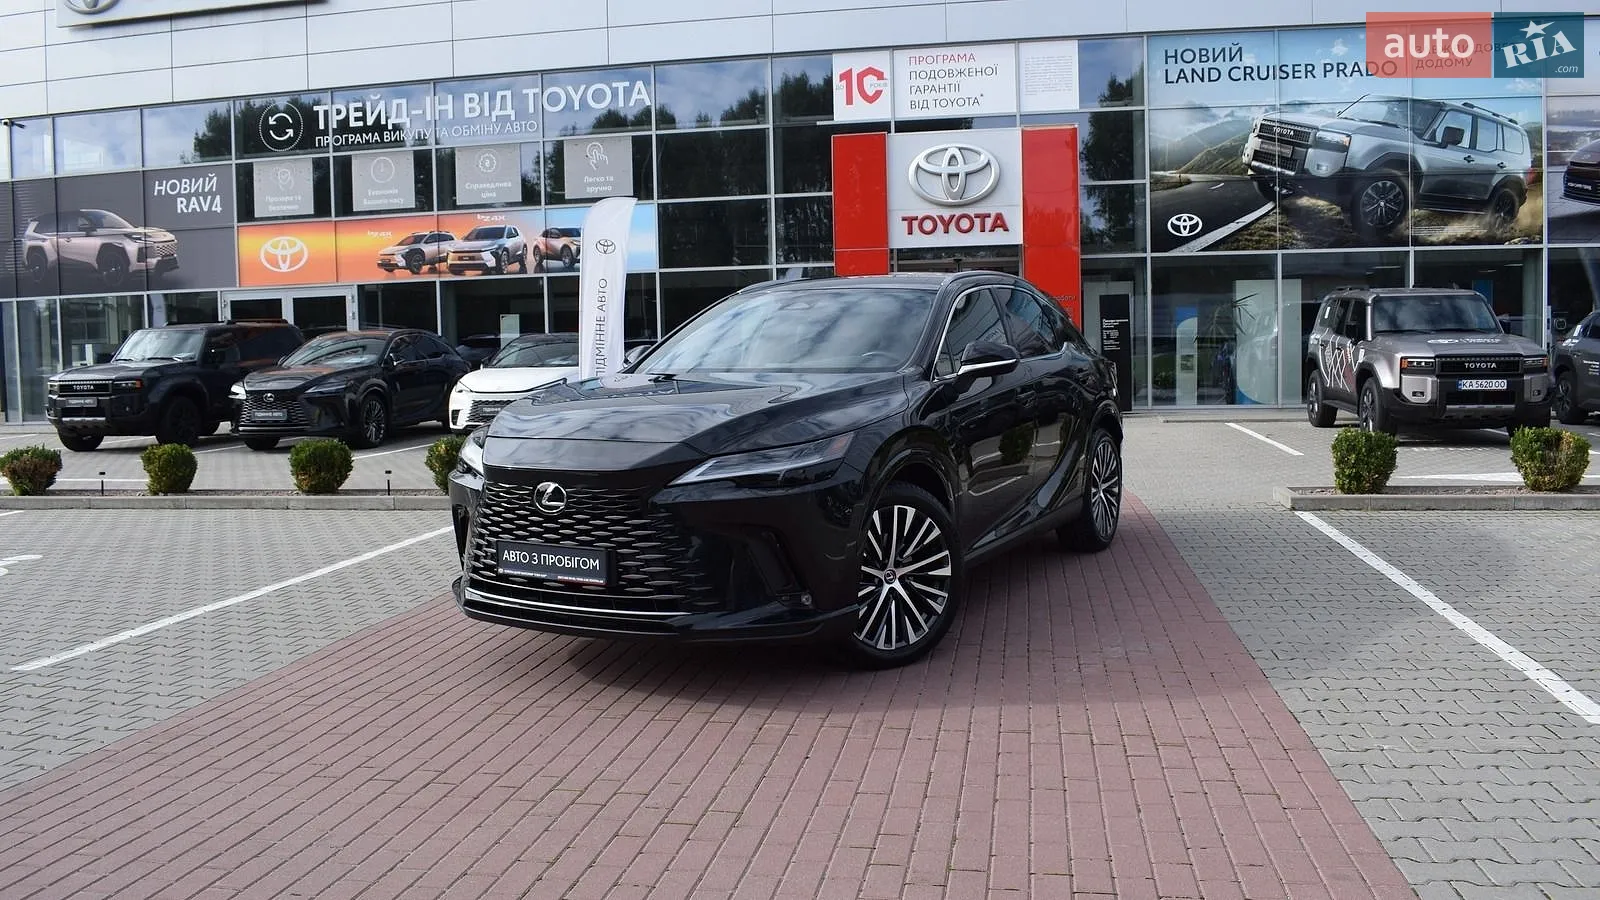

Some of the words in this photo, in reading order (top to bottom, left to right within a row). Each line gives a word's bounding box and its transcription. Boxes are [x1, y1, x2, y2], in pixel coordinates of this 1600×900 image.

[908, 52, 976, 66] ПРОГРАМА
[1164, 43, 1243, 65] НОВИЙ
[1415, 57, 1473, 71] ДОДОМУ
[909, 63, 999, 81] ПОДОВЖЕНОЇ
[1164, 67, 1221, 84] LAND
[1227, 64, 1316, 81] CRUISER
[1323, 60, 1398, 78] PRADO
[909, 82, 961, 96] ГАРАНТІЇ
[313, 94, 454, 130] ТРЕЙД-ІН
[463, 90, 516, 122] ВІД
[522, 80, 652, 114] TOYOTA
[910, 100, 930, 111] ВІД
[315, 131, 381, 147] ПРОГРАМА
[383, 126, 433, 142] ВИКУПУ
[435, 126, 449, 138] ТА
[451, 122, 502, 137] ОБМІНУ
[504, 120, 538, 134] АВТО
[1273, 126, 1294, 136] TOYOTA
[154, 173, 218, 196] НОВИЙ
[176, 194, 222, 214] RAV4
[901, 212, 1010, 236] TOYOTA
[598, 278, 608, 312] АВТО
[1462, 380, 1474, 388] KA
[1475, 380, 1493, 388] 5620
[502, 549, 530, 564] АВТО
[531, 552, 539, 565] З
[541, 553, 600, 571] ПРОБІГОМ
